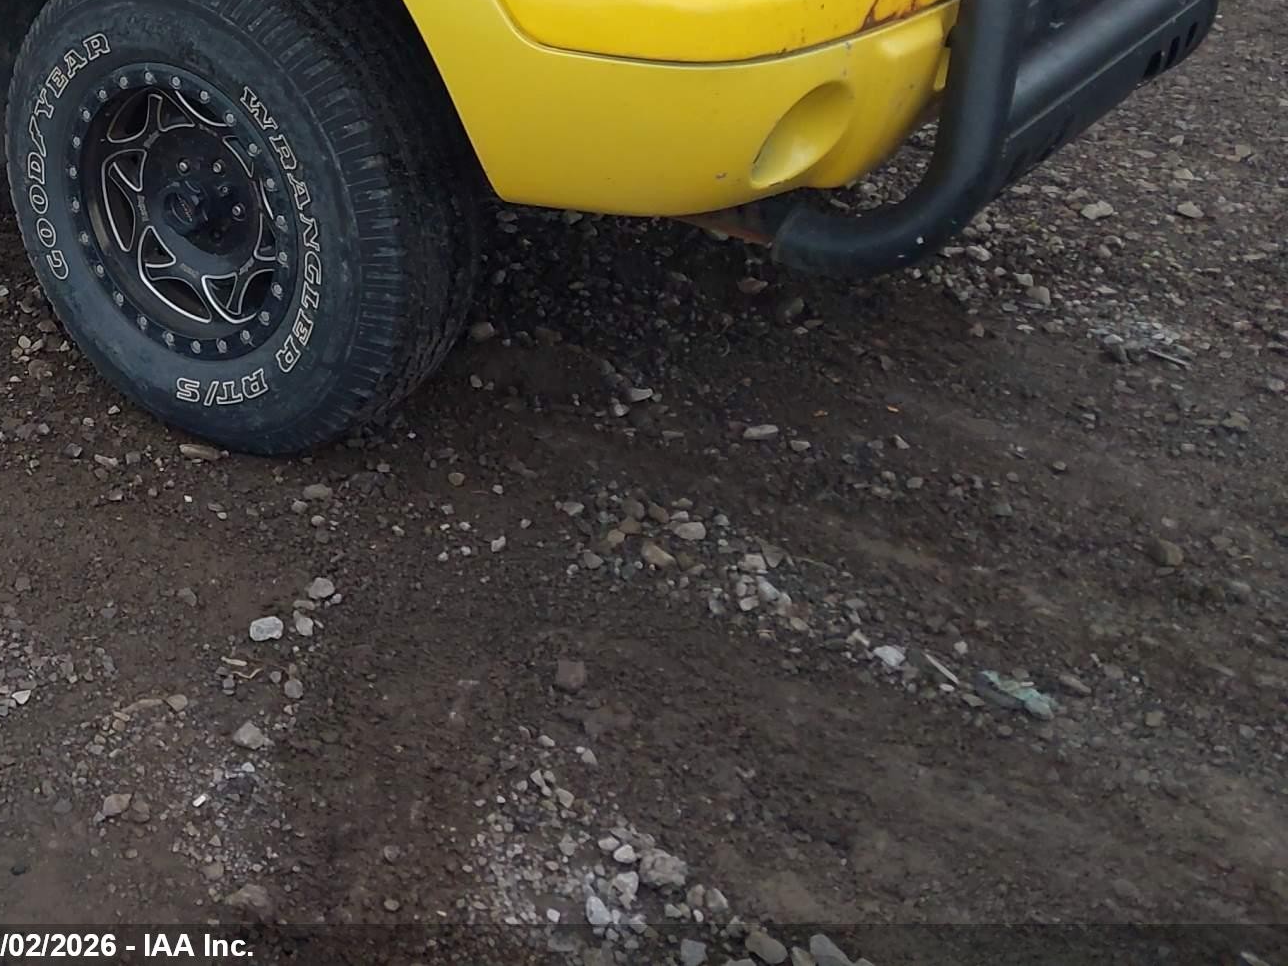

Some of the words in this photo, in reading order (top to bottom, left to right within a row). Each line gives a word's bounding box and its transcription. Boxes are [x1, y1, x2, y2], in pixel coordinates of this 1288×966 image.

[27, 32, 112, 280] GOODYEAR
[240, 85, 323, 374] WRANGLER
[175, 367, 270, 408] RT/S
